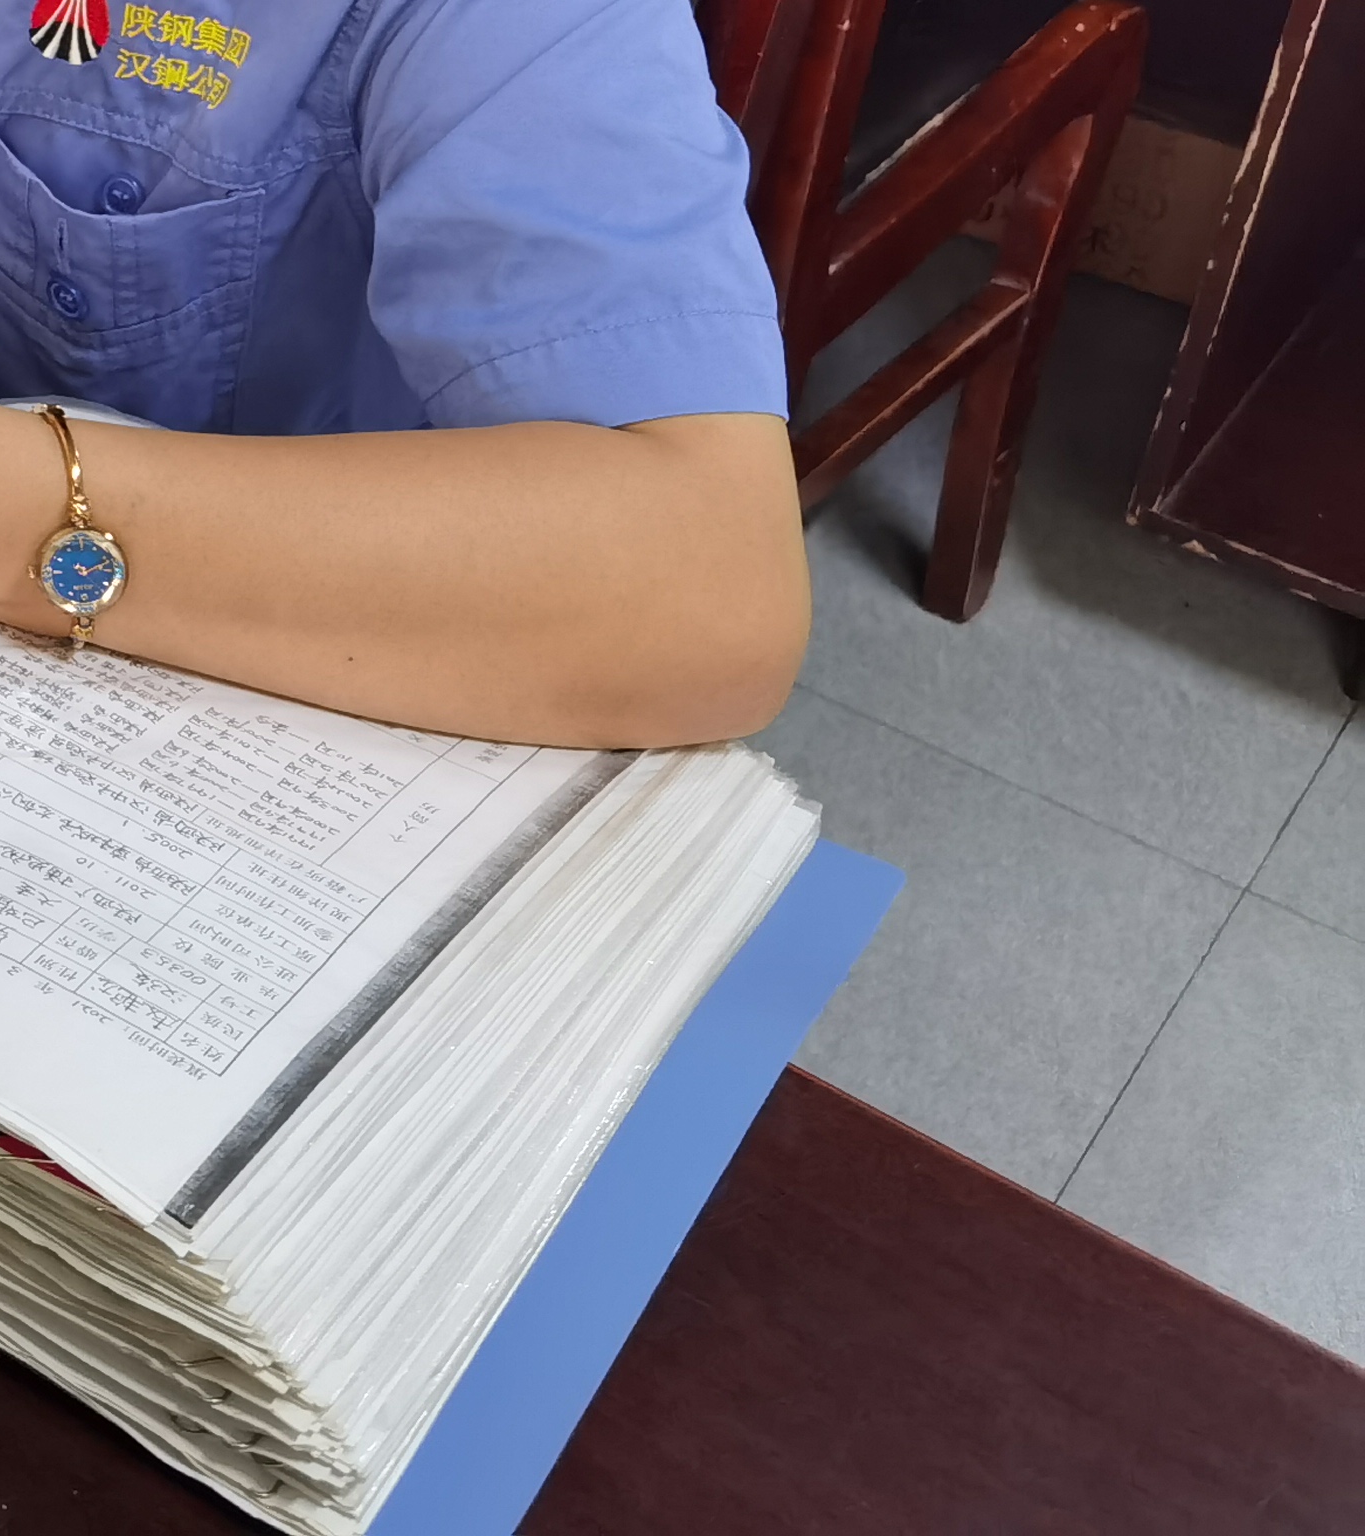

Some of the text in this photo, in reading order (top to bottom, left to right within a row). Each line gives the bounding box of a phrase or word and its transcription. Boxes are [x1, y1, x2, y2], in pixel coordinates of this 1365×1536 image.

[120, 2, 252, 69] 陕钢集团
[114, 48, 232, 110] 汉钢公司
[199, 816, 371, 903] 户籍所在详细地址
[210, 869, 340, 941] 参加工作时间
[241, 862, 358, 922] 现详细住址
[75, 917, 116, 942] 学历
[210, 903, 317, 964] 原工作单位
[56, 935, 98, 961] 婚否
[182, 919, 302, 982] 进公司时间
[6, 958, 27, 977] 3
[33, 954, 78, 982] 性别
[173, 937, 286, 1000] 毕业院校
[33, 973, 61, 995] 年
[71, 1000, 114, 1024] 2021
[219, 995, 258, 1020] 工号
[200, 1011, 244, 1041] 民族
[180, 1031, 225, 1063] 姓名
